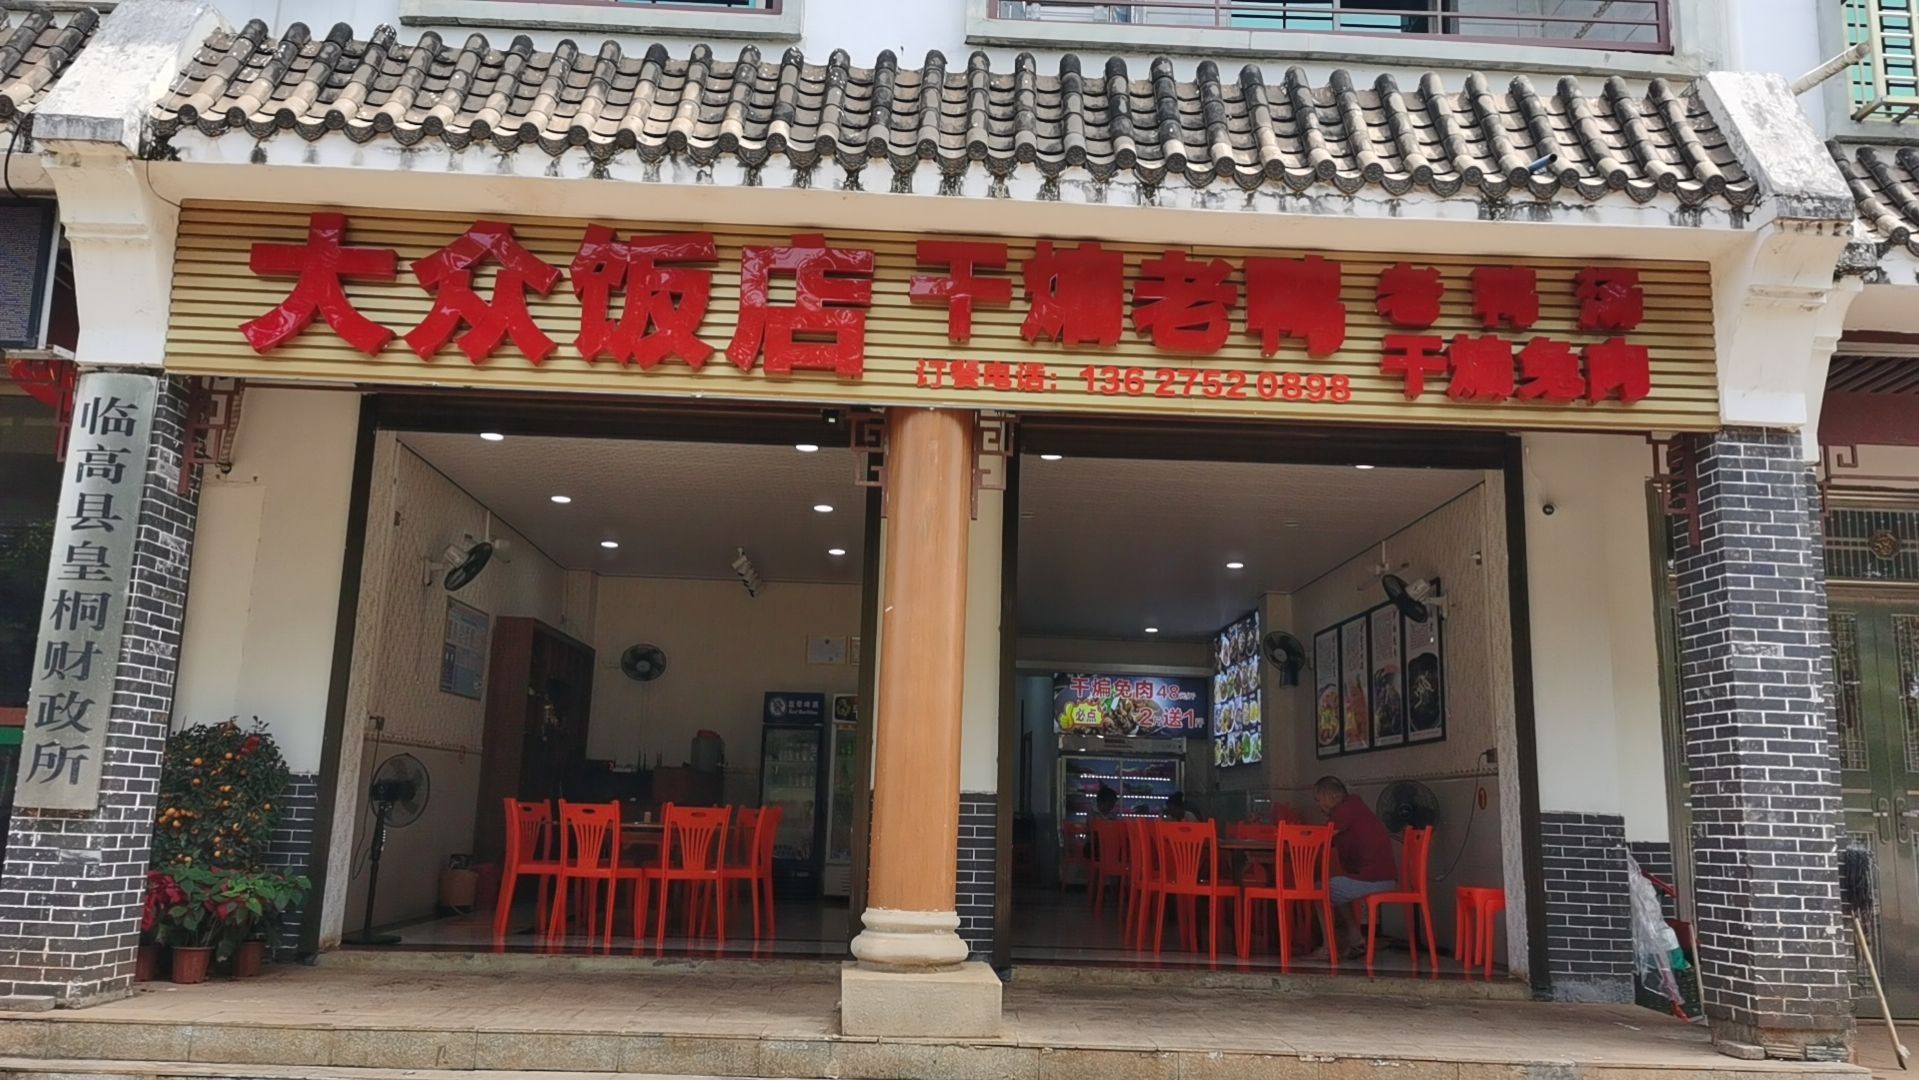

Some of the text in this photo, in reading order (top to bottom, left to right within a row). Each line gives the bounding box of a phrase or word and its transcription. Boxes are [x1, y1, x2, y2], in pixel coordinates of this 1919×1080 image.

[238, 210, 876, 385] 大众饭店
[908, 239, 1347, 358] 干煸老鸭
[1375, 261, 1645, 332] 老鸭汤
[1078, 364, 1146, 397] 136
[1154, 367, 1248, 400] 2752
[1255, 370, 1353, 403] 0898
[25, 395, 139, 786] 临高县皇桐财政所
[1075, 708, 1098, 723] 必点
